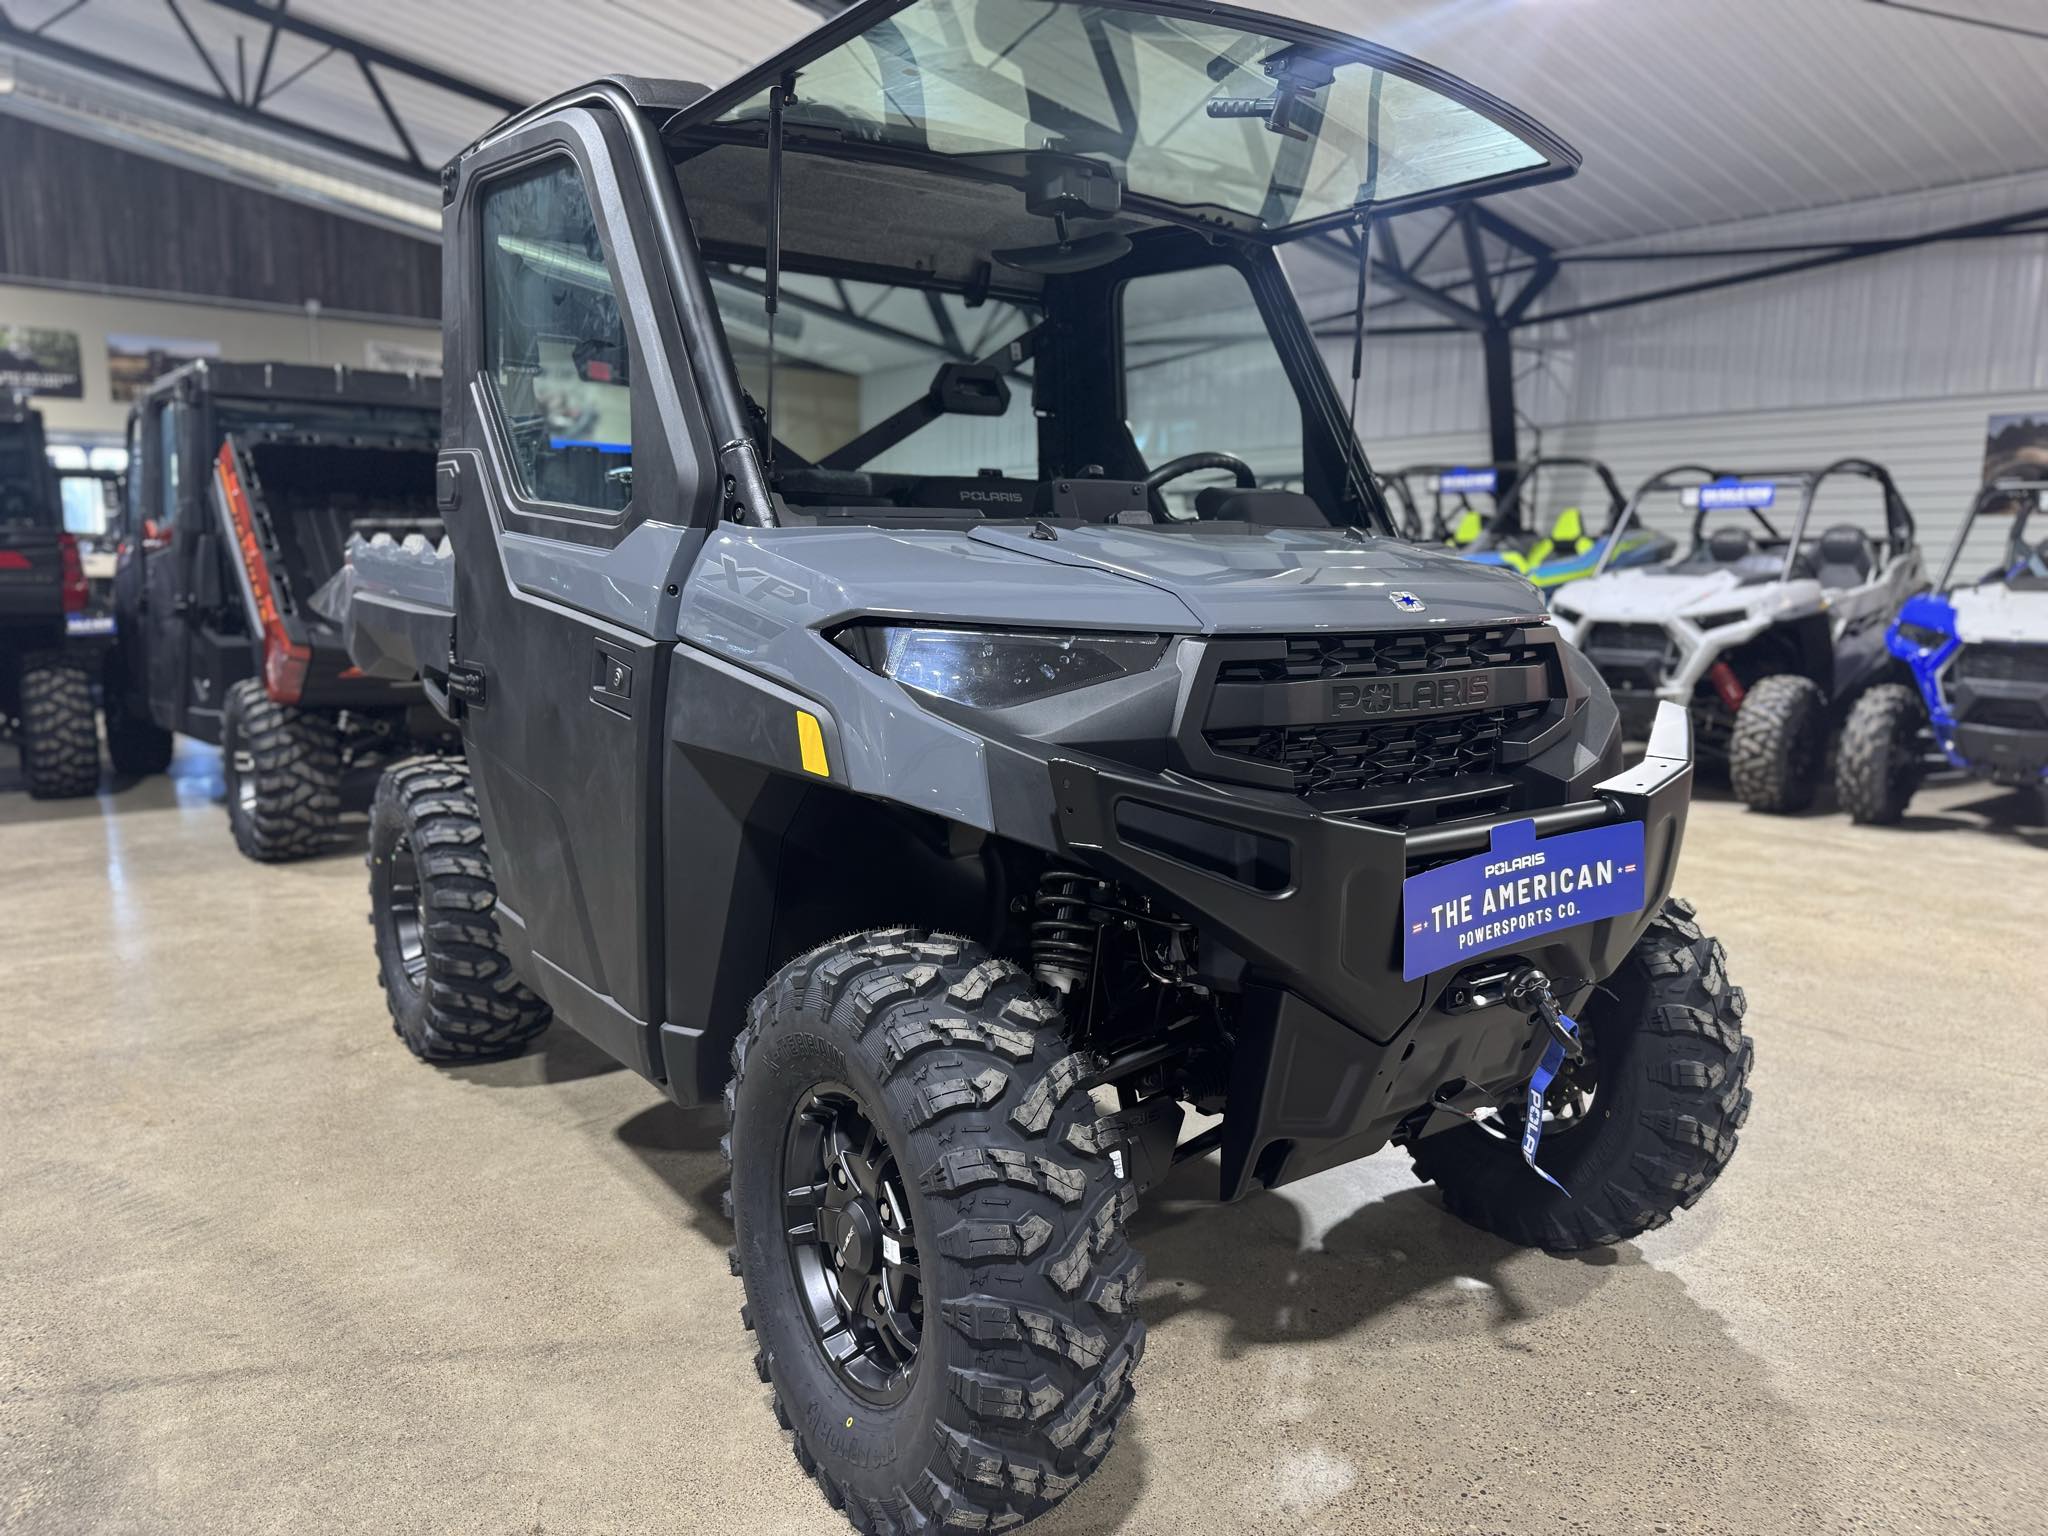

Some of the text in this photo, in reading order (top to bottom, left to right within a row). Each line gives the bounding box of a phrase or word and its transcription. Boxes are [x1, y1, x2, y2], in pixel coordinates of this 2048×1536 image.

[959, 490, 1023, 503] POLARIS
[700, 552, 811, 605] XP
[1331, 674, 1489, 717] POLARIS
[1485, 852, 1546, 878] POLARIS
[1431, 859, 1613, 933] THE AMERICAN
[1459, 901, 1581, 949] POWERSPORTS CO.
